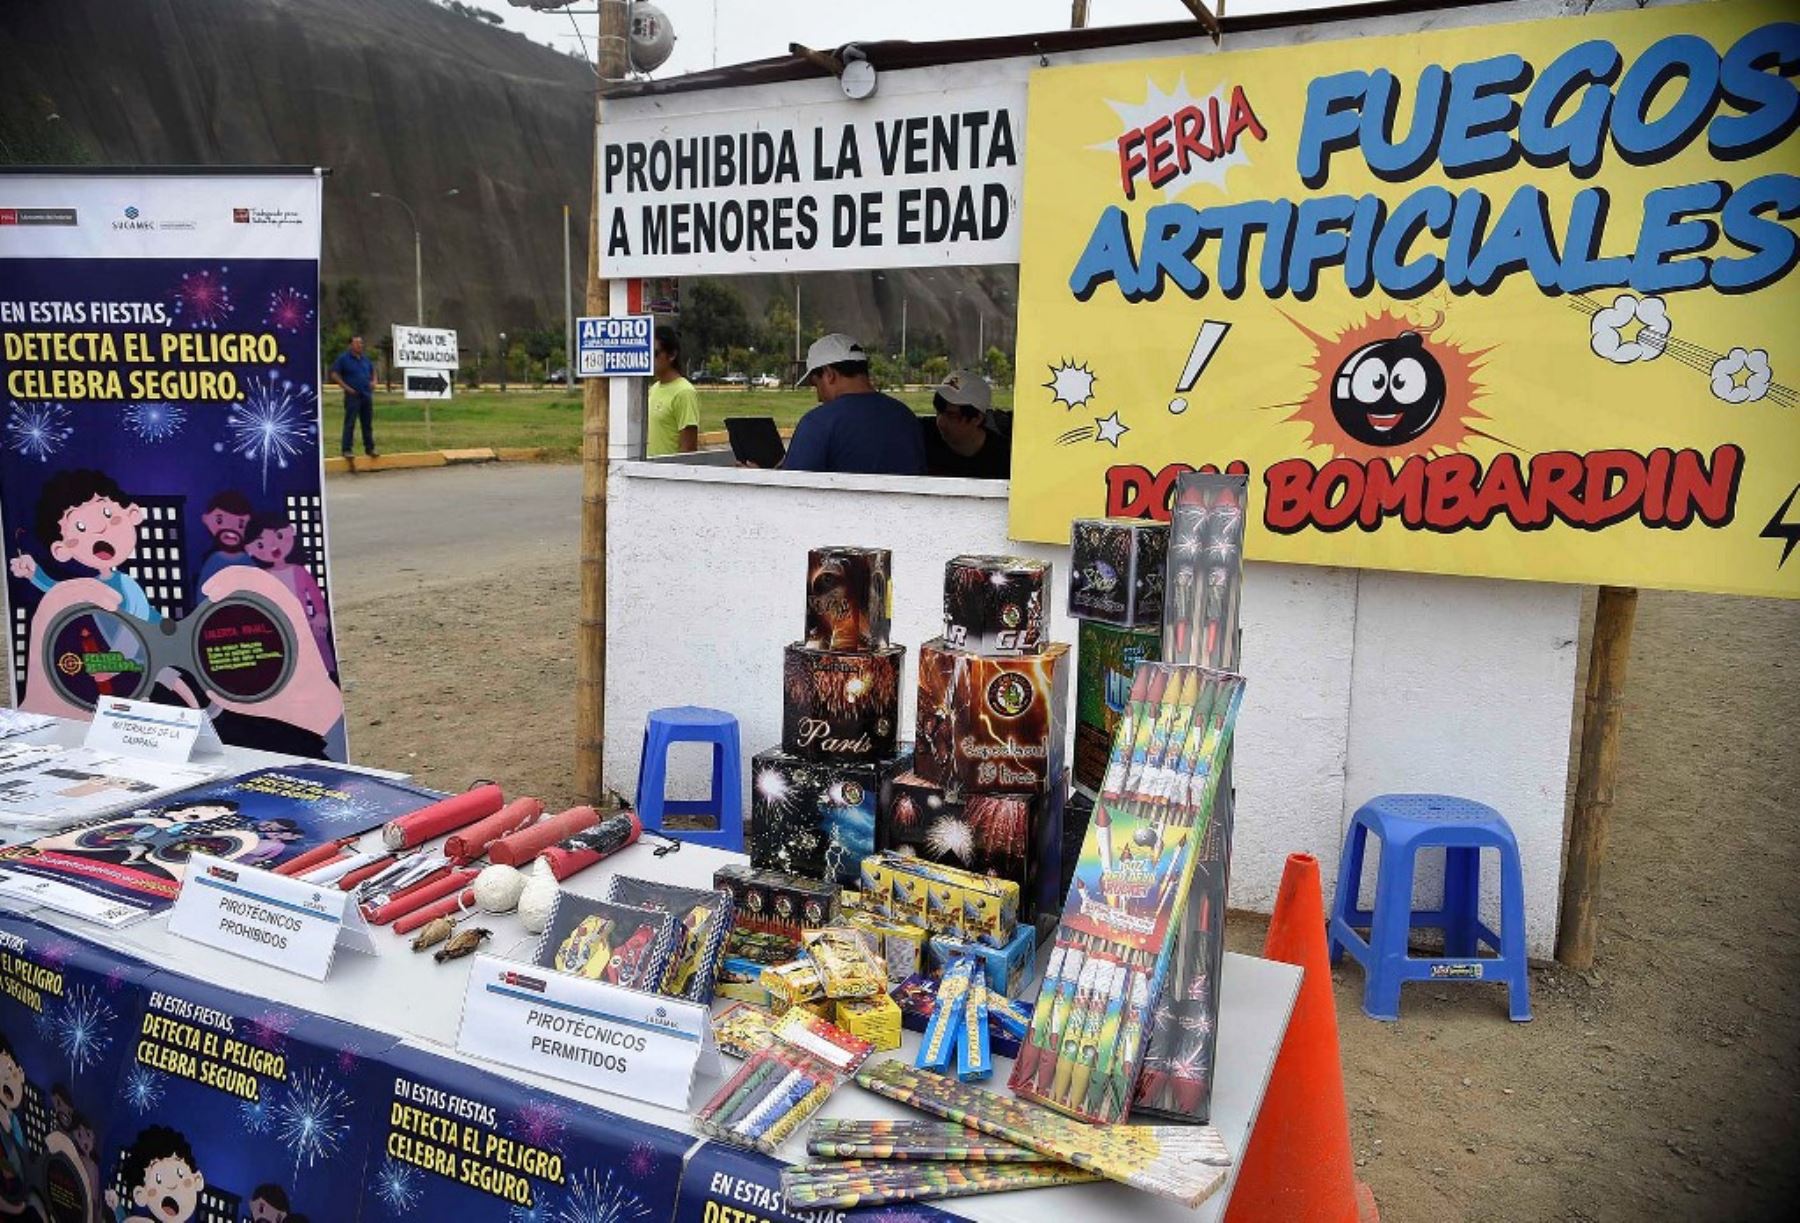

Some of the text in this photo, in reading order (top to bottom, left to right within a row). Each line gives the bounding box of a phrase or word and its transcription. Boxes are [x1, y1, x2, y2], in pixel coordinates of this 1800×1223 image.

[1297, 22, 1800, 189] FUEGOS
[605, 108, 1017, 194] PROHIBIDA LA VENTA
[1117, 85, 1267, 200] FERIA
[607, 182, 1009, 257] A MENORES DE EDAD
[1067, 173, 1800, 303] ARTIFICIALES
[1, 301, 172, 327] EN ESTAS FIESTAS,
[582, 319, 648, 339] AFORO
[4, 333, 286, 363] DETECTA EL PELIGRO.
[407, 332, 433, 346] ZONA
[605, 350, 649, 370] PERSONAS
[8, 369, 245, 400] CELEBRA SEGURO.
[1264, 444, 1745, 535] BOMBARDIN
[797, 716, 872, 753] Paris
[219, 897, 303, 932] PIROTÉCNICOS
[219, 918, 288, 949] PROHIBIDOS
[1, 952, 14, 974] EL
[15, 957, 64, 997] PELIGRO.
[4, 976, 43, 1014] SEGURO.
[149, 991, 235, 1035] EN ESTAS FIESTAS,
[526, 1009, 647, 1052] PIROTÉCNICOS
[142, 1012, 287, 1081] DETECTA EL PELIGRO.
[531, 1035, 627, 1073] PERMITIDOS
[137, 1040, 259, 1101] CELEBRA SEGURO.
[394, 1078, 498, 1130] EN ESTAS FIESTAS,
[391, 1102, 565, 1185] DETECTA EL PELIGRO.
[388, 1132, 533, 1207] CELEBRA SEGURO.
[710, 1171, 733, 1197] EN
[734, 1179, 781, 1211] ESTAS
